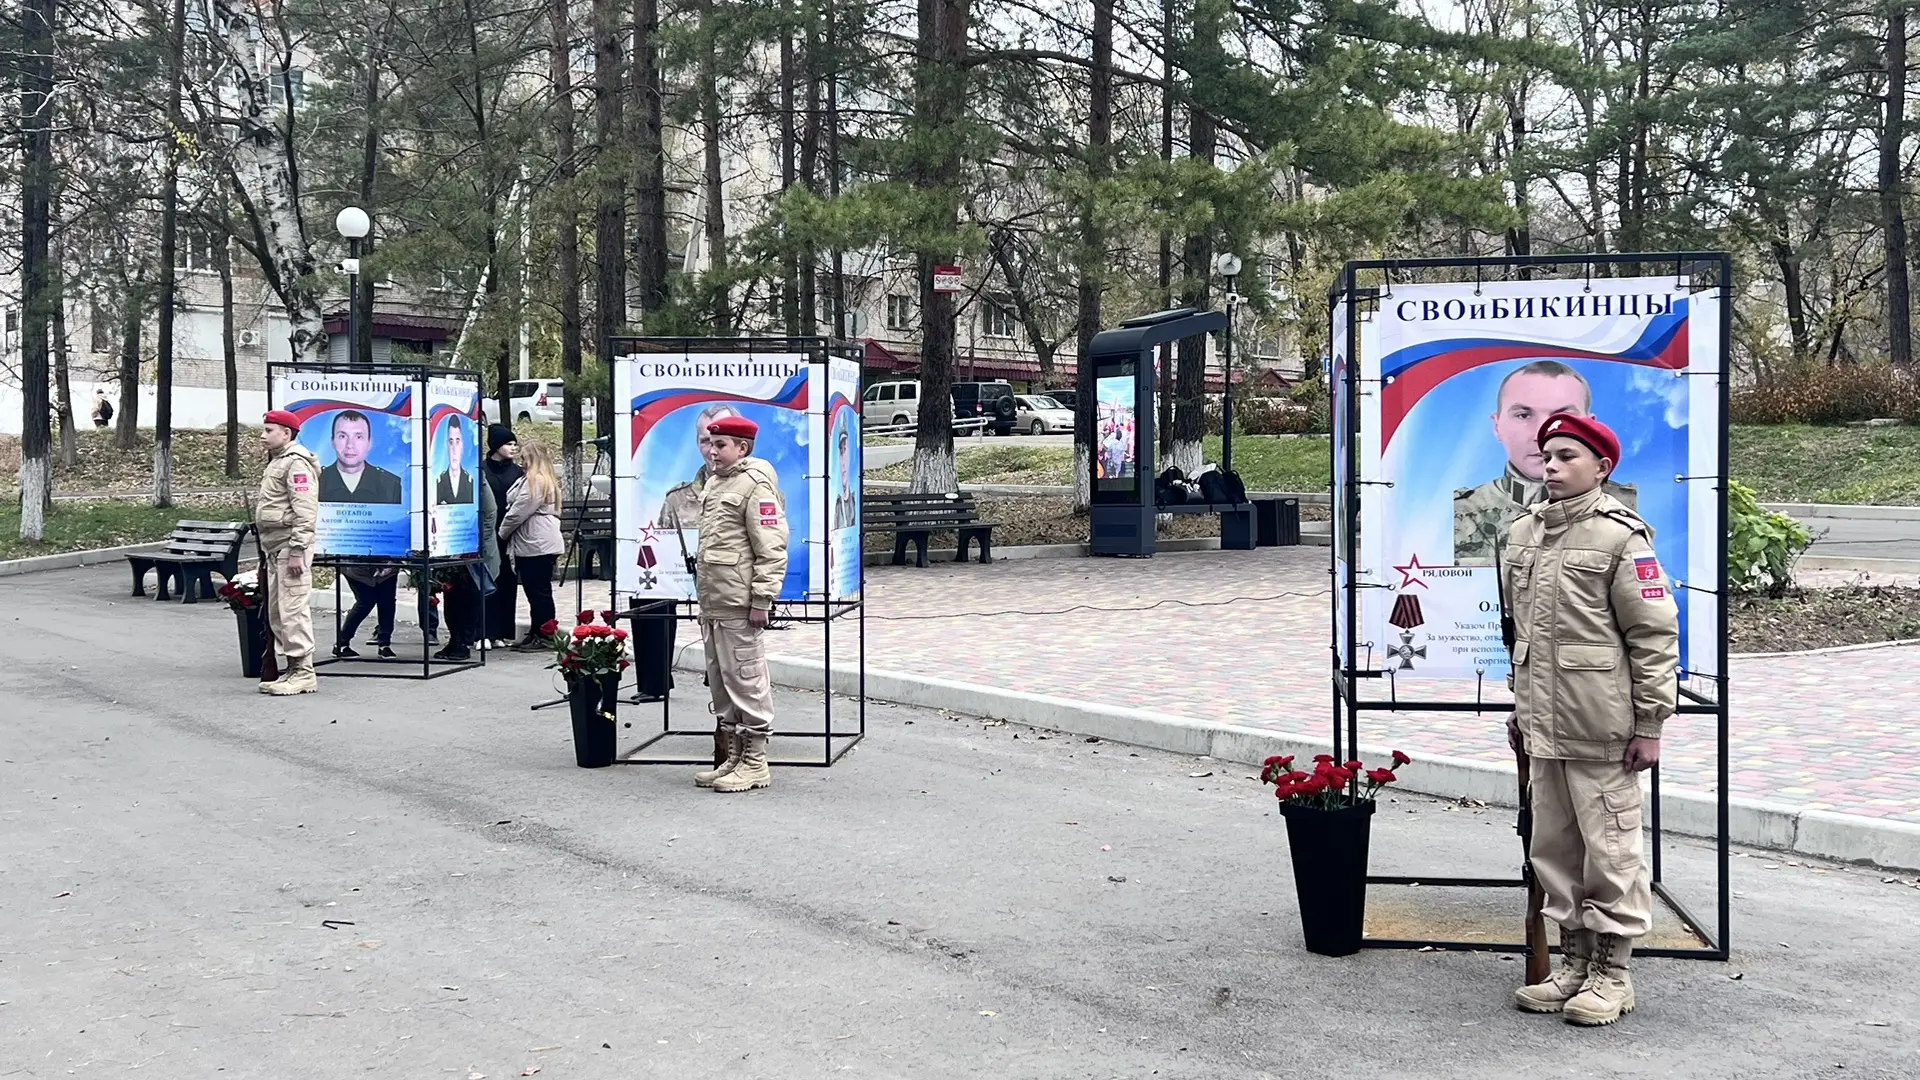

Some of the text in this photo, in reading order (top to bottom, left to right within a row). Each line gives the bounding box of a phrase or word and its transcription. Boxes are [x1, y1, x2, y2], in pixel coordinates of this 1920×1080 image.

[1396, 293, 1675, 321] СВОиБИКИНЦЫ
[639, 363, 800, 380] СВОиБИКИНЦЫ
[290, 380, 405, 393] СВОиБИКИНЦЫ
[1422, 568, 1472, 578] РЯДОВОЙ
[1478, 600, 1500, 613] Ол
[1454, 621, 1485, 630] Указом
[1426, 633, 1436, 641] За
[1438, 634, 1482, 643] мужество,
[1452, 645, 1506, 654] при исполне
